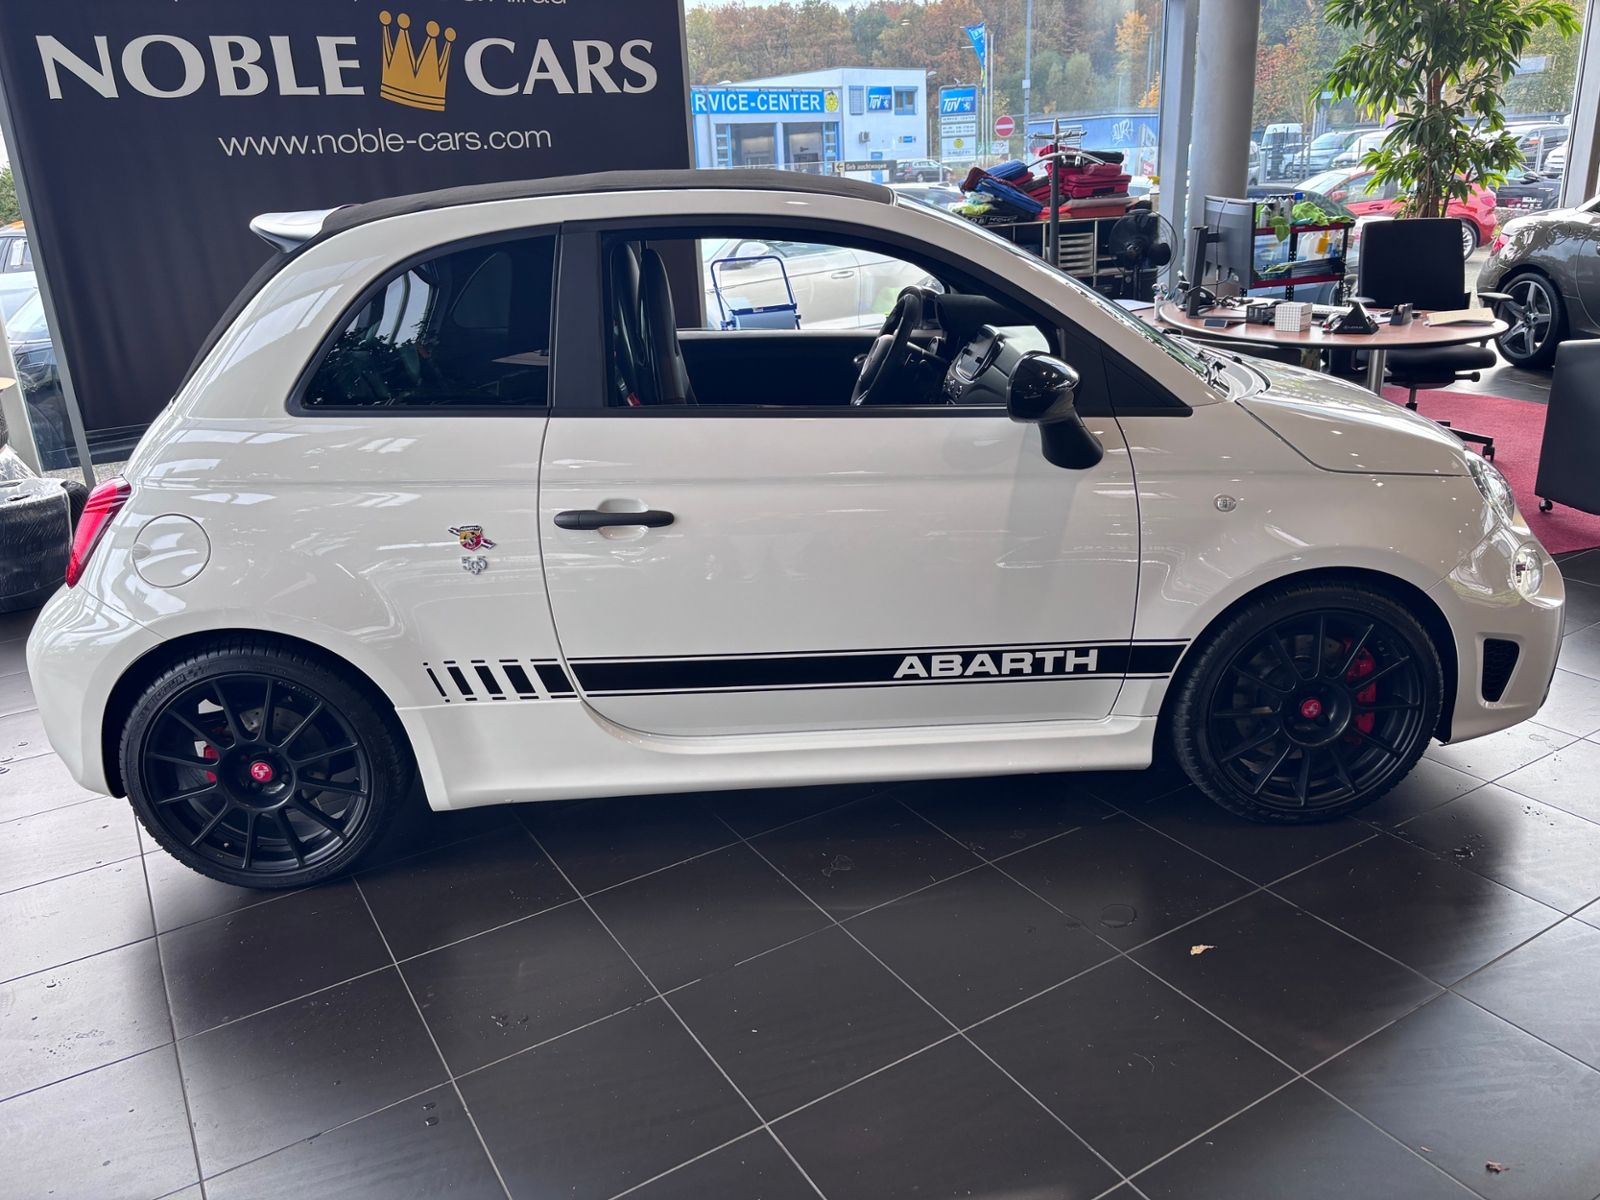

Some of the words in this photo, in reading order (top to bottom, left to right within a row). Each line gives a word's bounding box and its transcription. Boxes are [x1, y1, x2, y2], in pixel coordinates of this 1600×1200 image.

[36, 35, 365, 100] NOBLE
[464, 38, 658, 96] CARS
[693, 93, 821, 111] RVICE-CENTER
[217, 127, 552, 157] www.noble-cars.com
[893, 648, 1098, 679] ABARTH
